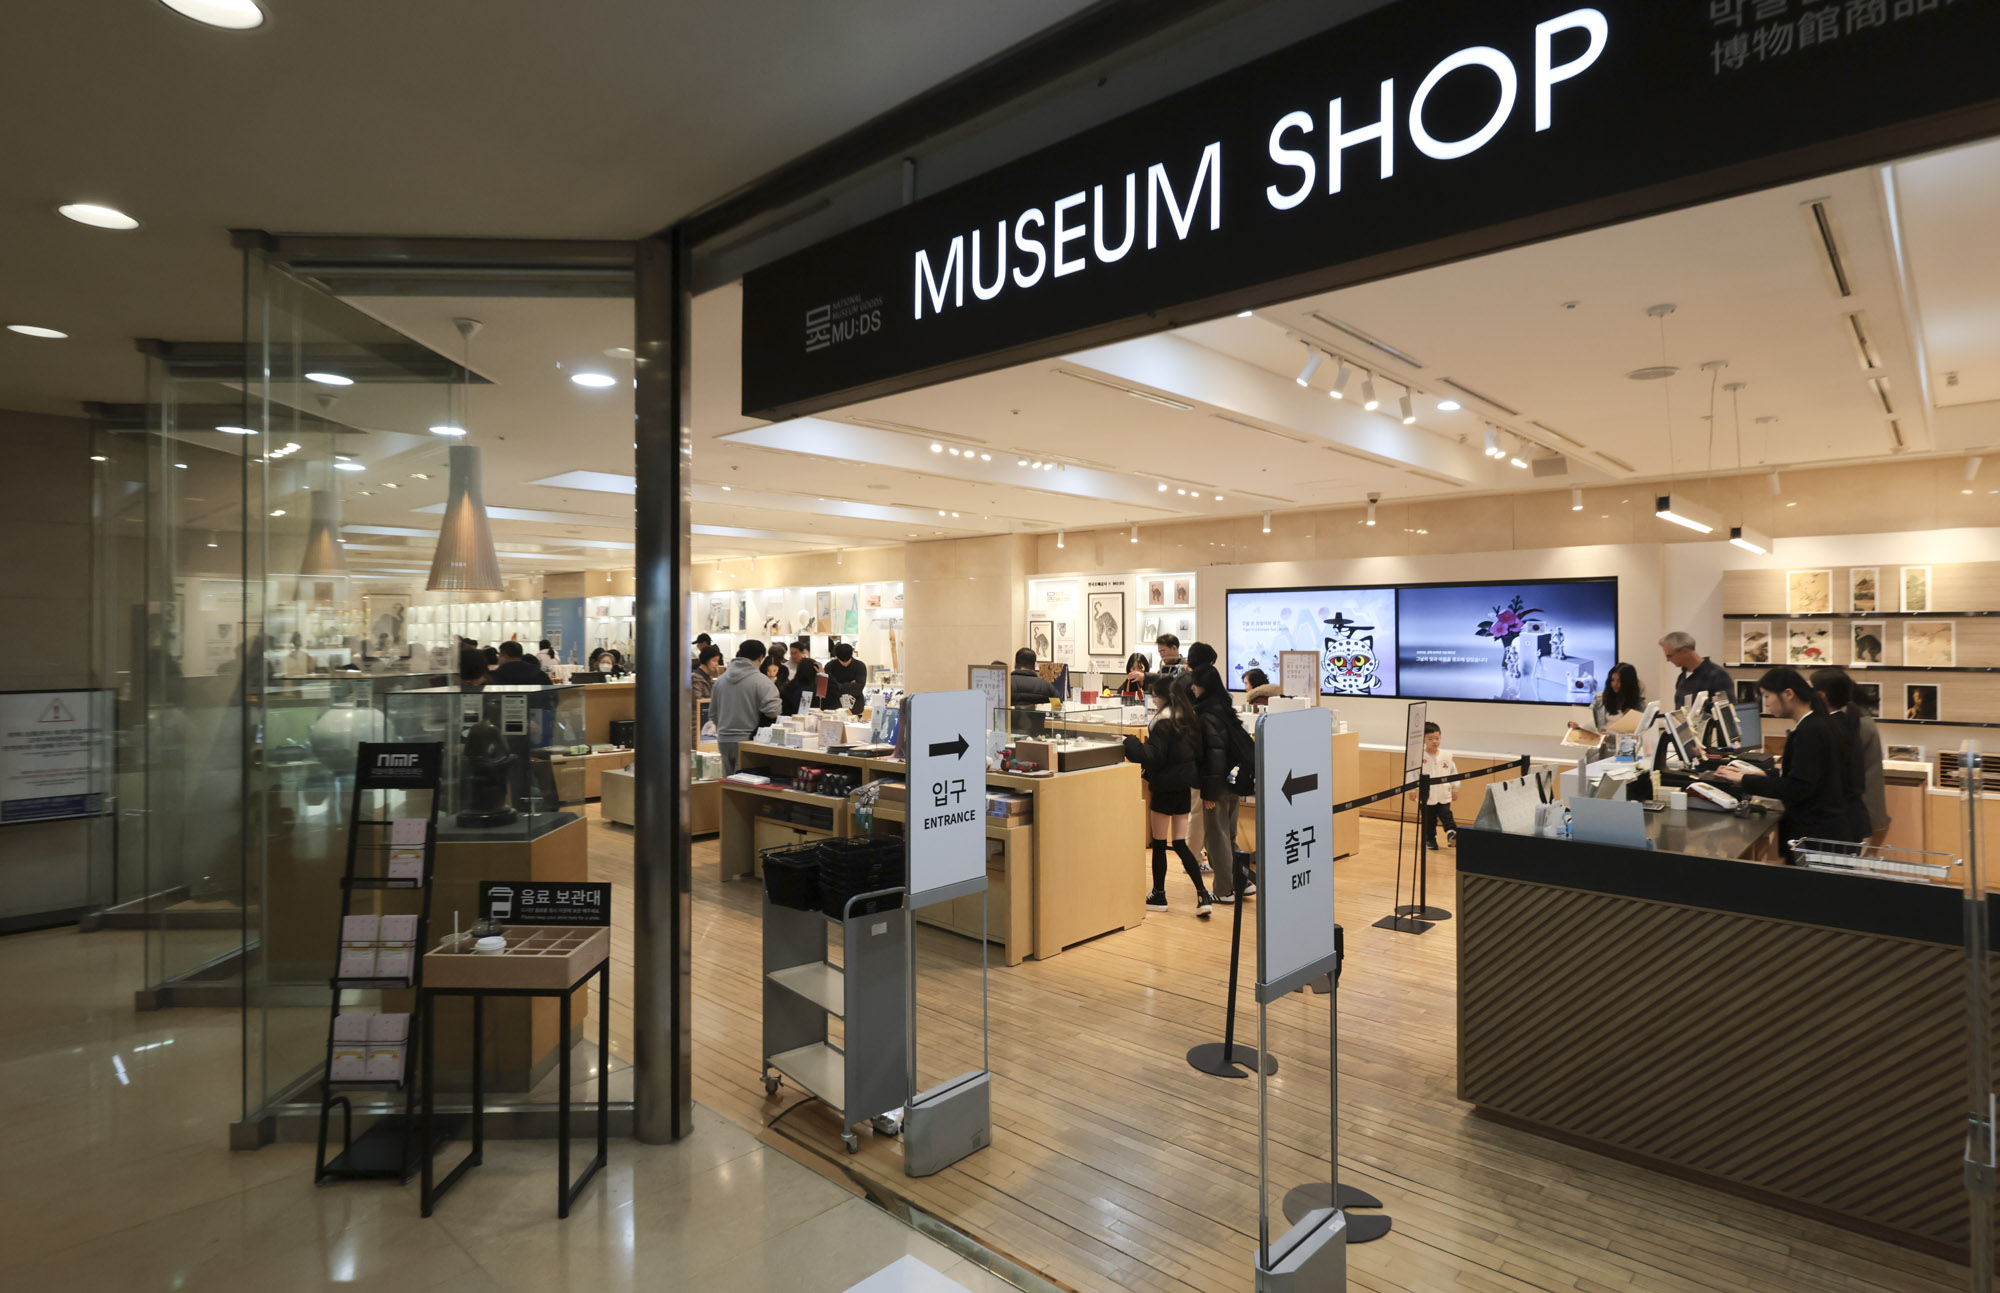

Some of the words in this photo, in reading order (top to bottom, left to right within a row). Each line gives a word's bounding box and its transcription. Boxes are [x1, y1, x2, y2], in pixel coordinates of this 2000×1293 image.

[914, 140, 1222, 320] MUSEUM
[1266, 7, 1609, 211] SHOP
[832, 305, 860, 321] MUSEUM
[860, 296, 883, 312] GOODS
[832, 310, 881, 344] MU:DS
[932, 778, 967, 808] 입구
[924, 809, 976, 830] ENTRANCE
[1284, 825, 1316, 865] 출구
[1291, 869, 1312, 890] EXIT
[520, 888, 551, 905] 음료
[556, 889, 601, 906] 보관대
